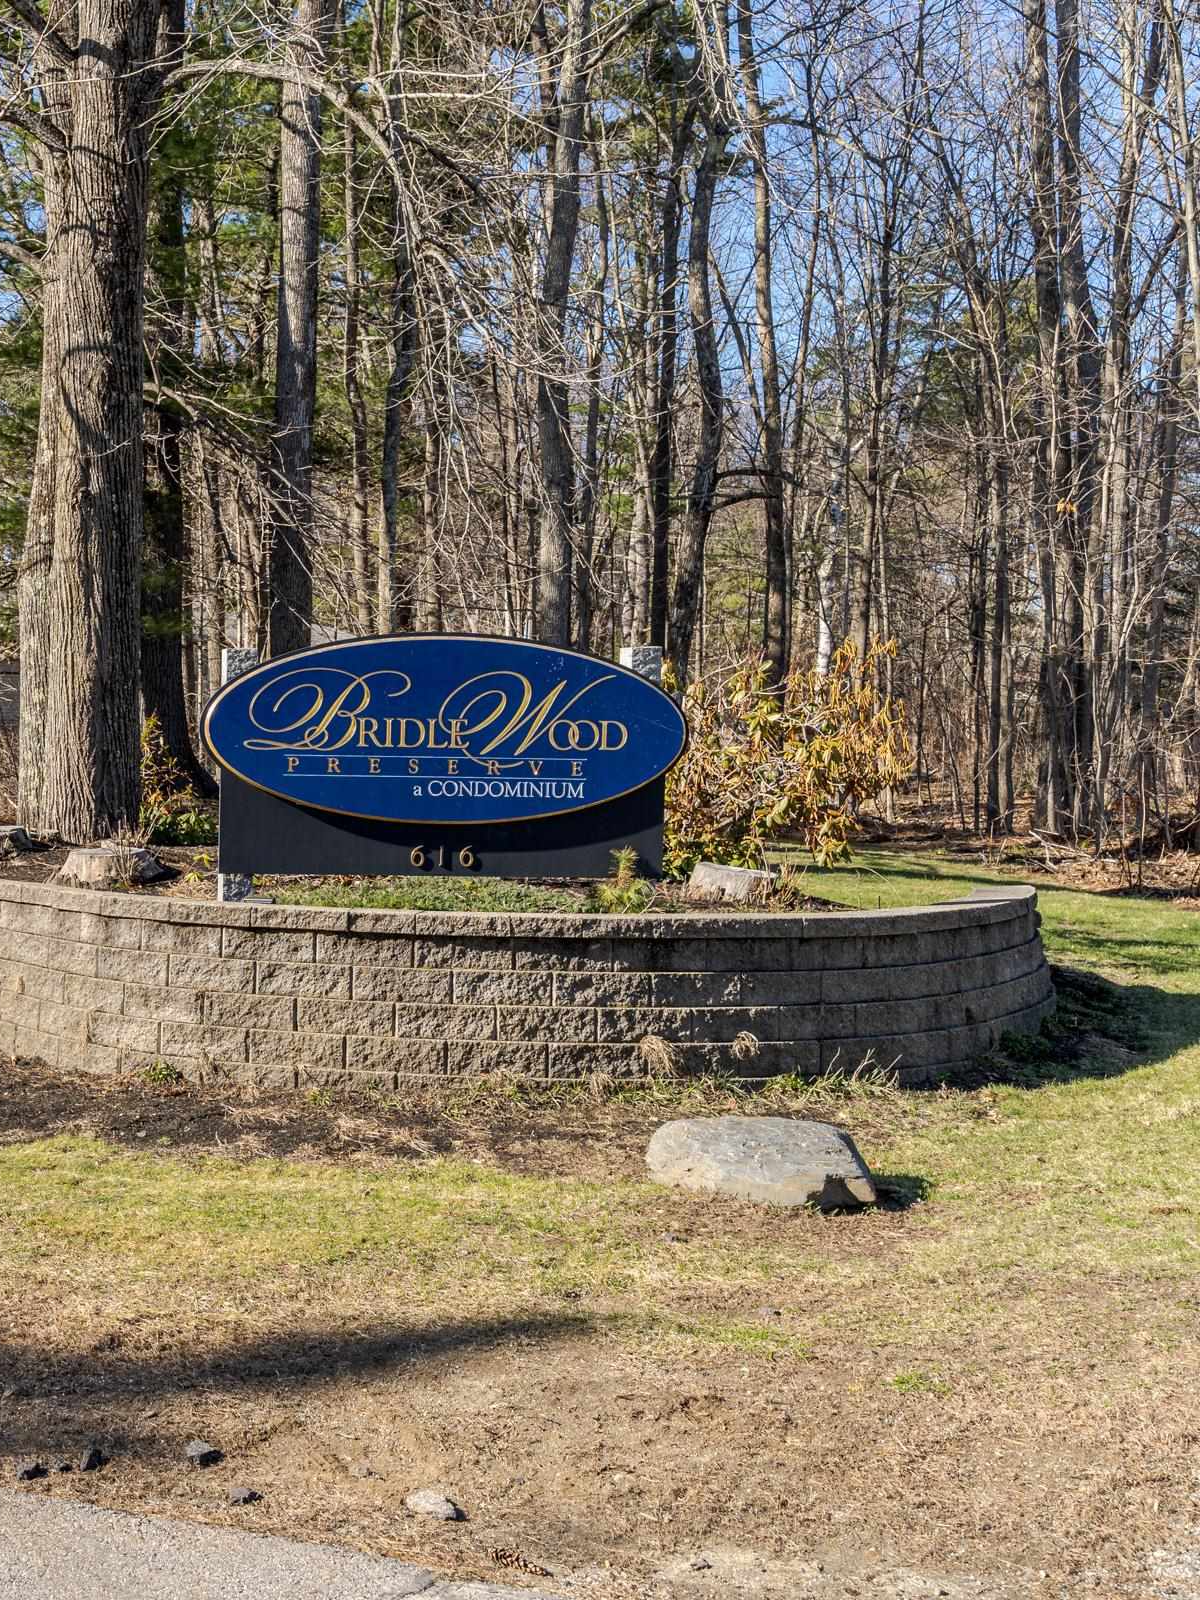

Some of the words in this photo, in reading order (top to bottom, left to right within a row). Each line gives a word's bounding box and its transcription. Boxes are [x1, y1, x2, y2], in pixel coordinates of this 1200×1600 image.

[287, 756, 583, 776] PRESERVE
[413, 784, 423, 797] a
[428, 780, 585, 798] CONDOMINIUM
[410, 845, 475, 868] 616
